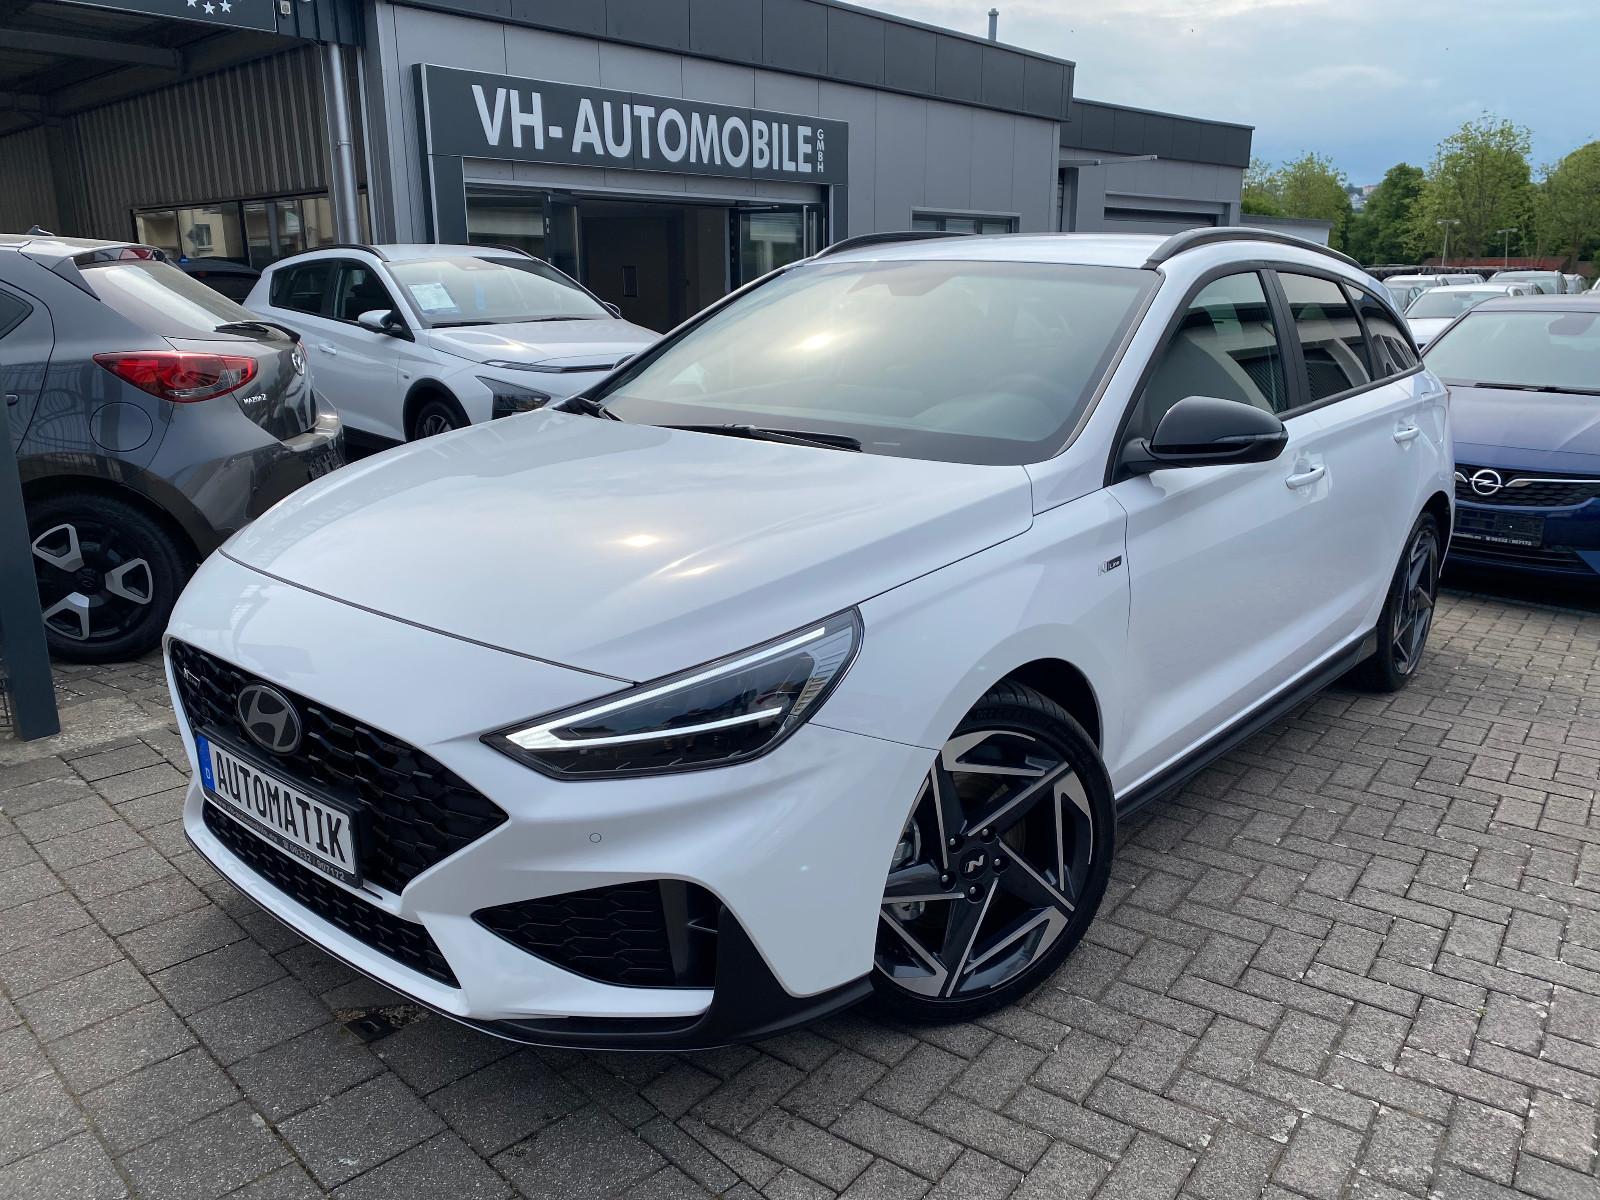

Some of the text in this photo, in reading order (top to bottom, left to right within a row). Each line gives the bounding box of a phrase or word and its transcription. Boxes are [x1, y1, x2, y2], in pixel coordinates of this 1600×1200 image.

[471, 84, 813, 173] VH- AUTOMOBILE
[816, 128, 825, 173] GMBH
[215, 750, 346, 864] AUTOMATIK
